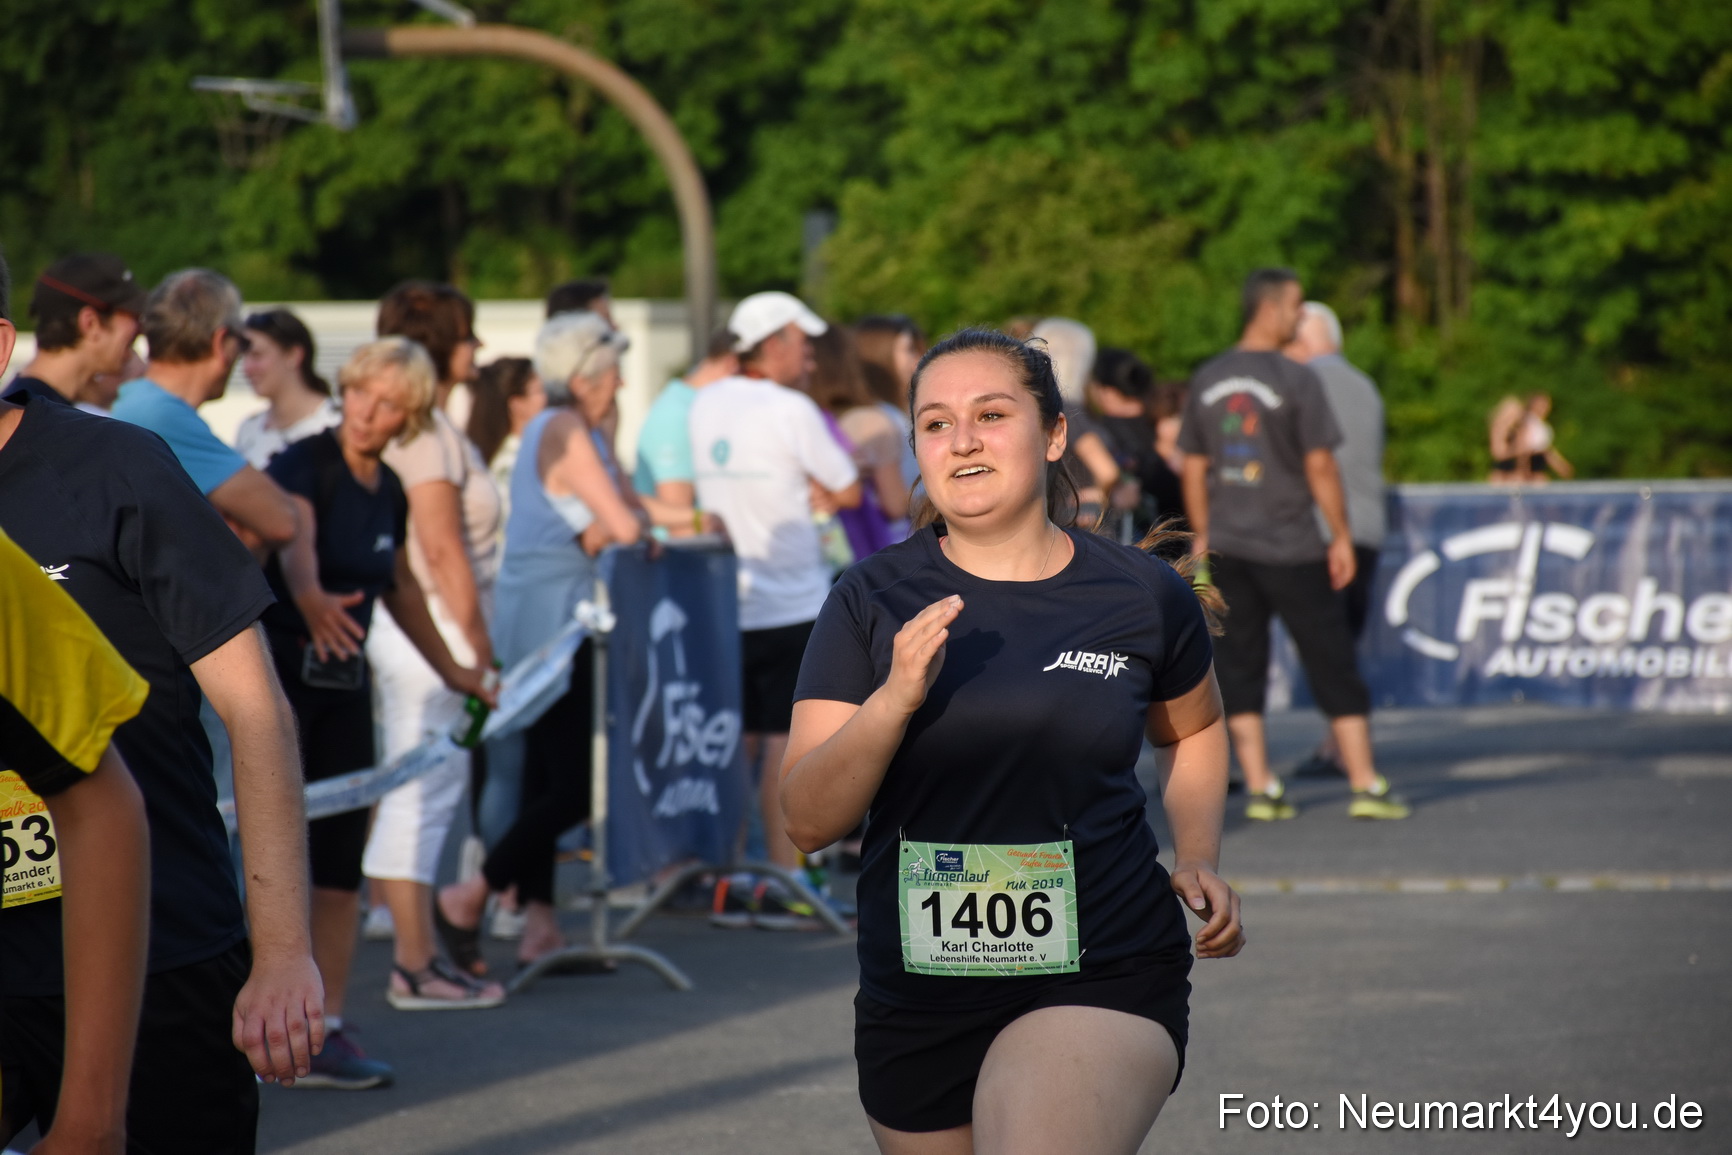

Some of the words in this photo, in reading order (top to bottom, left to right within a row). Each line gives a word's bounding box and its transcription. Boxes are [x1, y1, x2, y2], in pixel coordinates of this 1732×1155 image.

[1043, 651, 1109, 671] JURA
[1484, 646, 1732, 679] AUTOMOBIL
[29, 800, 48, 814] 20
[48, 876, 55, 884] V
[923, 868, 990, 882] firmenlauf
[1032, 877, 1064, 890] 2019
[921, 891, 1053, 939] 1406
[941, 941, 968, 952] Karl
[971, 941, 1034, 953] Charlotte
[930, 954, 981, 963] Lebenshilfe
[983, 955, 1027, 963] Neumarkt
[1039, 953, 1047, 961] V
